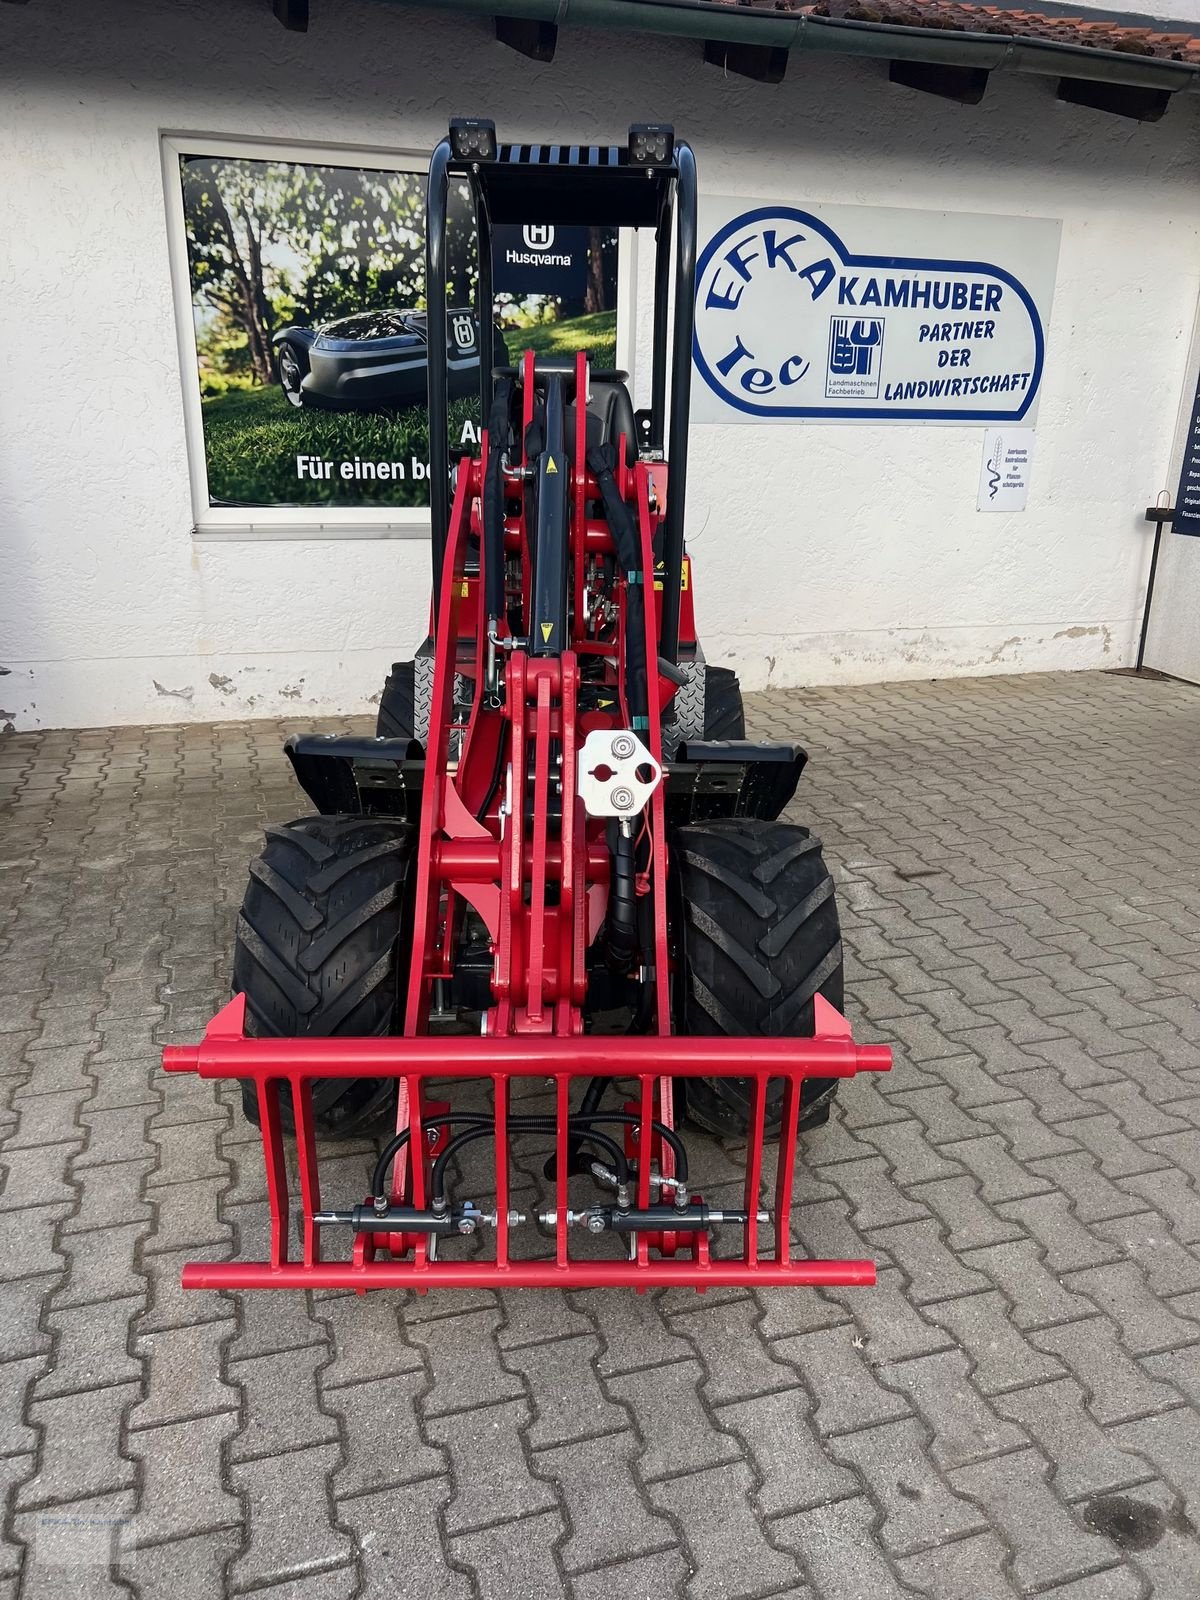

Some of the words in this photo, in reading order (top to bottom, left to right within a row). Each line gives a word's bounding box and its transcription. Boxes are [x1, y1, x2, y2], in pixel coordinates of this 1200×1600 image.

[506, 249, 571, 266] Husqvarna
[705, 230, 836, 311] EFKA
[837, 276, 1003, 312] KAMHUBER
[918, 319, 995, 343] PARTNER
[716, 335, 810, 394] Tec
[937, 348, 971, 368] DER
[828, 388, 866, 396] Fachbetrieb
[884, 372, 1031, 401] LANDWIRTSCHAFT
[296, 455, 334, 479] Für
[340, 456, 405, 479] einen
